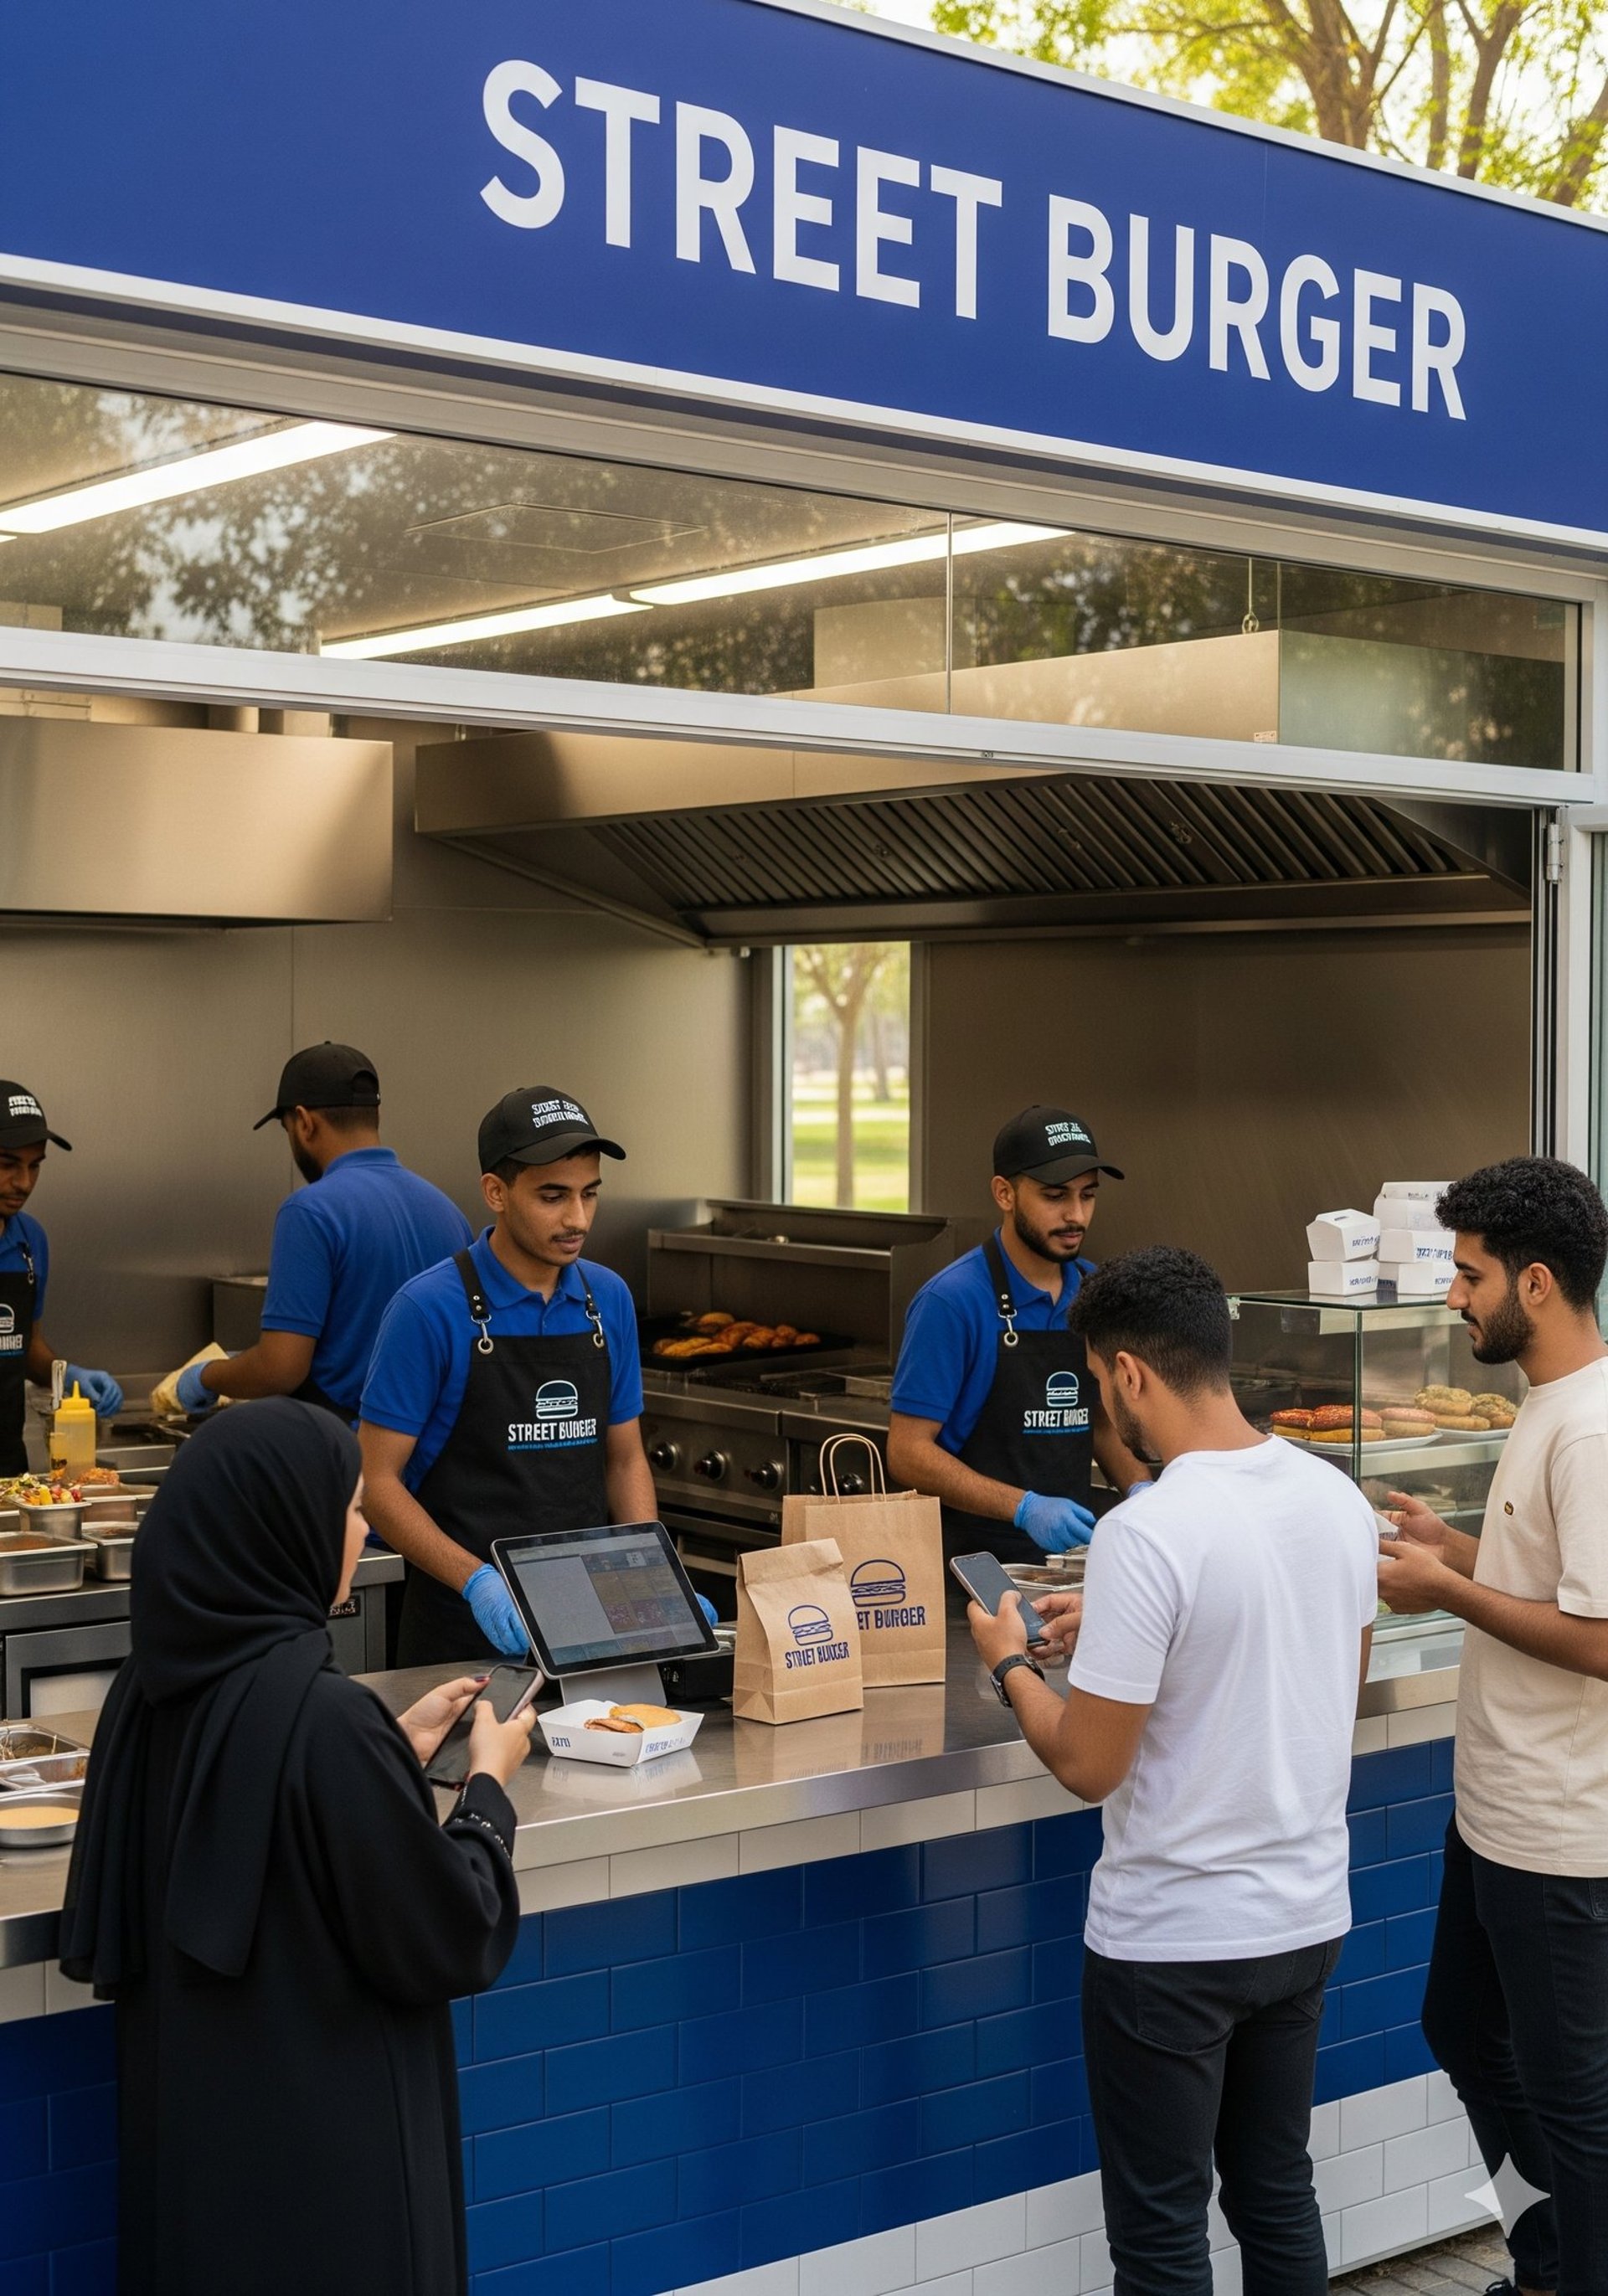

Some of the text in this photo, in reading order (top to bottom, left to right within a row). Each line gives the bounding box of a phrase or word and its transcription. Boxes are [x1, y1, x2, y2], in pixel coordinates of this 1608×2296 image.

[480, 59, 1466, 420] STREET BURGER
[508, 1423, 558, 1442] STREET
[874, 1606, 926, 1629] BURGER
